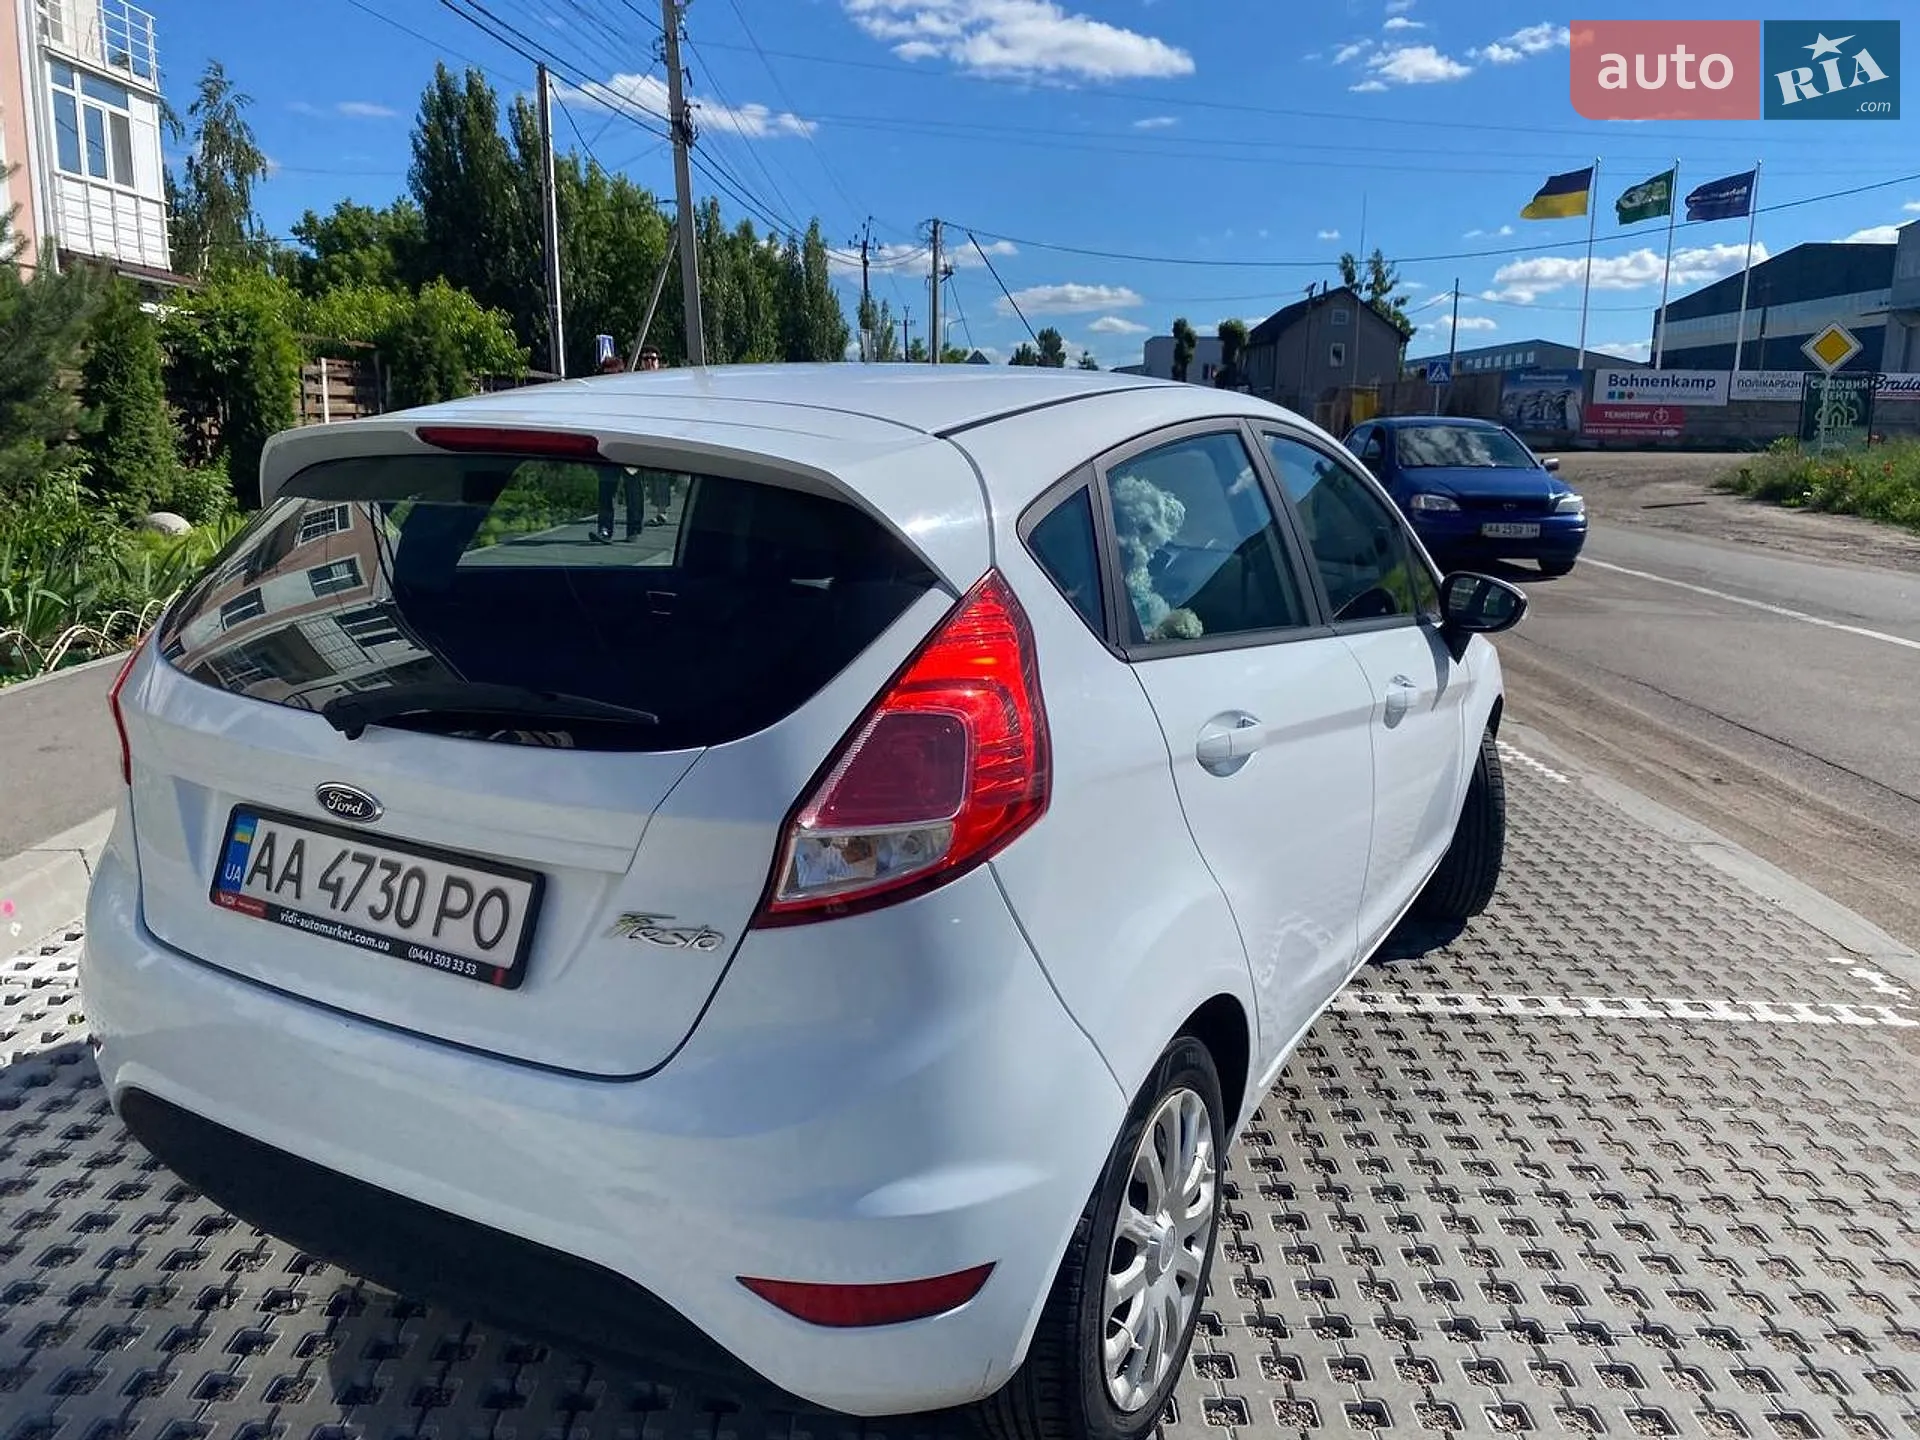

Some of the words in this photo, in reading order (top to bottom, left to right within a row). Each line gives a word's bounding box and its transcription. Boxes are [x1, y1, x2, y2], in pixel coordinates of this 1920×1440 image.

[1608, 373, 1716, 391] Bohnenkamp
[326, 790, 363, 816] Ford
[224, 863, 242, 883] UA
[245, 830, 306, 900] AA
[318, 849, 427, 929] 4730
[432, 875, 511, 951] PO
[280, 910, 391, 951] vidi-automarket.com.ua
[408, 945, 433, 964] (044)
[434, 953, 451, 969] 503
[452, 958, 465, 973] 33
[465, 963, 478, 976] 53
